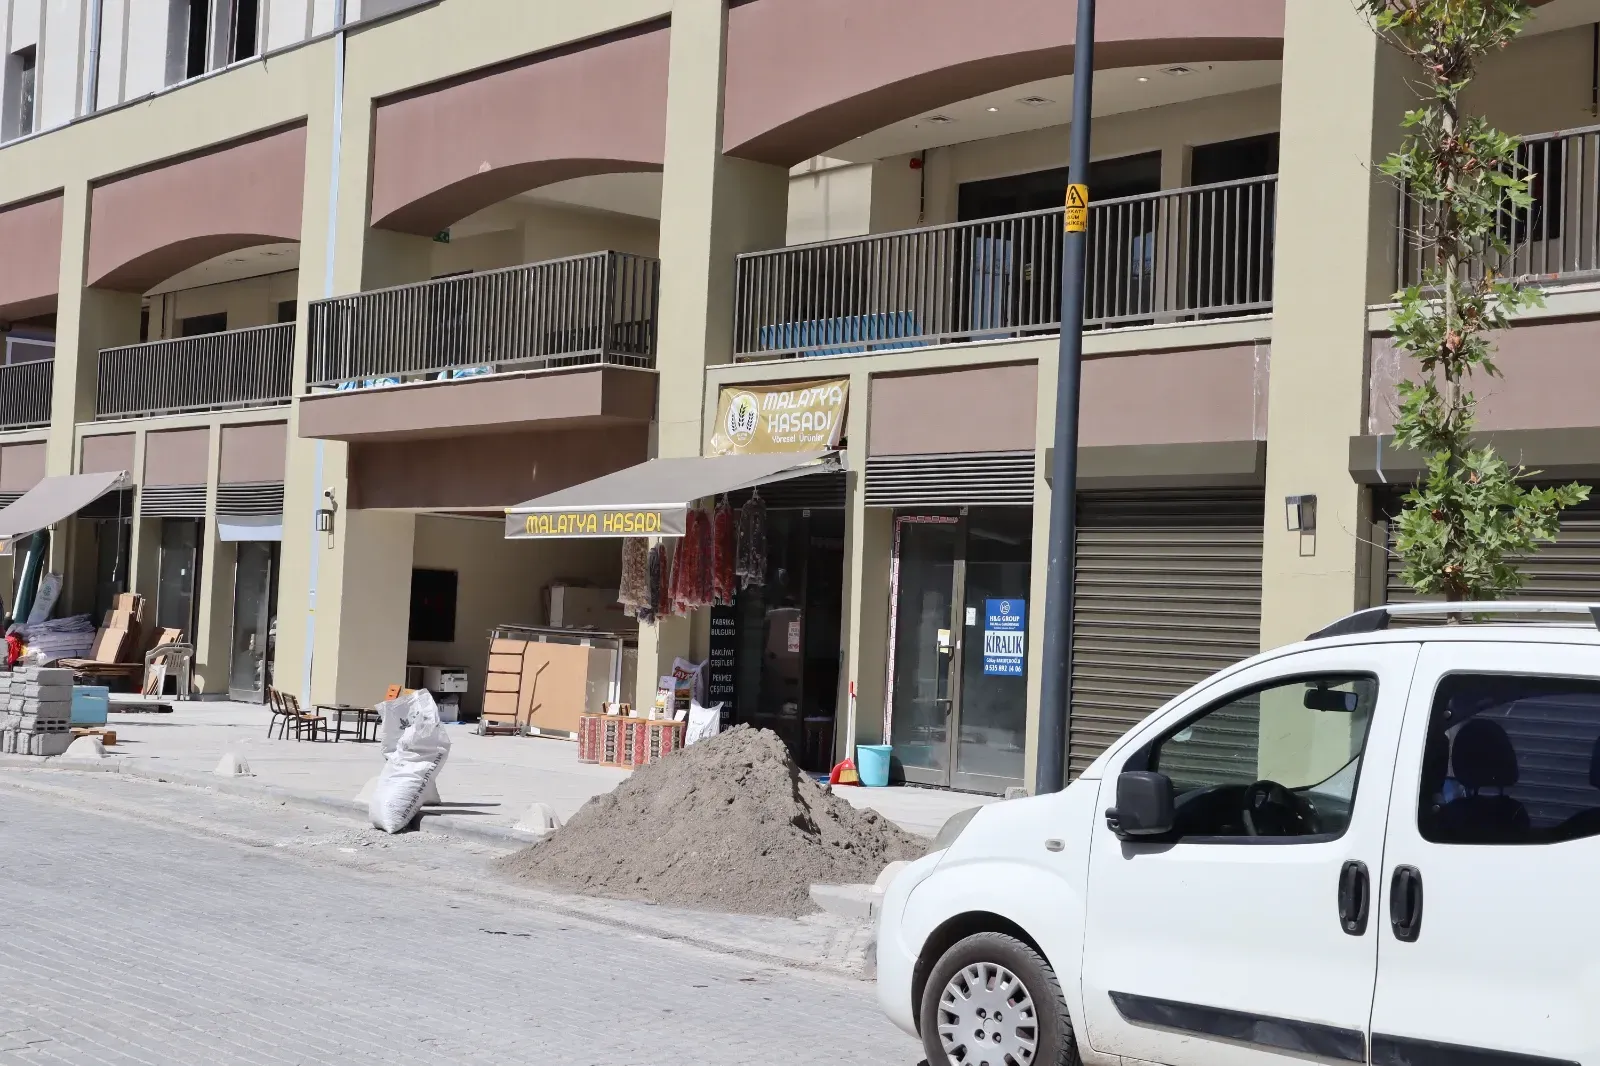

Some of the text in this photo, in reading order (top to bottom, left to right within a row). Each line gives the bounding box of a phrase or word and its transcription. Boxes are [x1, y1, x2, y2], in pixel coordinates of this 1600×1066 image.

[763, 386, 842, 410] MALATYA
[768, 411, 832, 433] HASADI
[771, 431, 825, 444] Yöresel Ürünler
[525, 512, 662, 534] MALATYA HASADI
[711, 628, 736, 636] BULGURU
[986, 632, 1022, 654] KİRALIK
[711, 647, 735, 656] BAKLİYAT
[710, 657, 735, 668] ÇEŞİTLERİ
[998, 664, 1008, 672] 892
[712, 673, 732, 682] PEKMEZ
[709, 683, 734, 695] ÇEŞİTLERİ
[417, 752, 444, 794] MUTLUCAN
